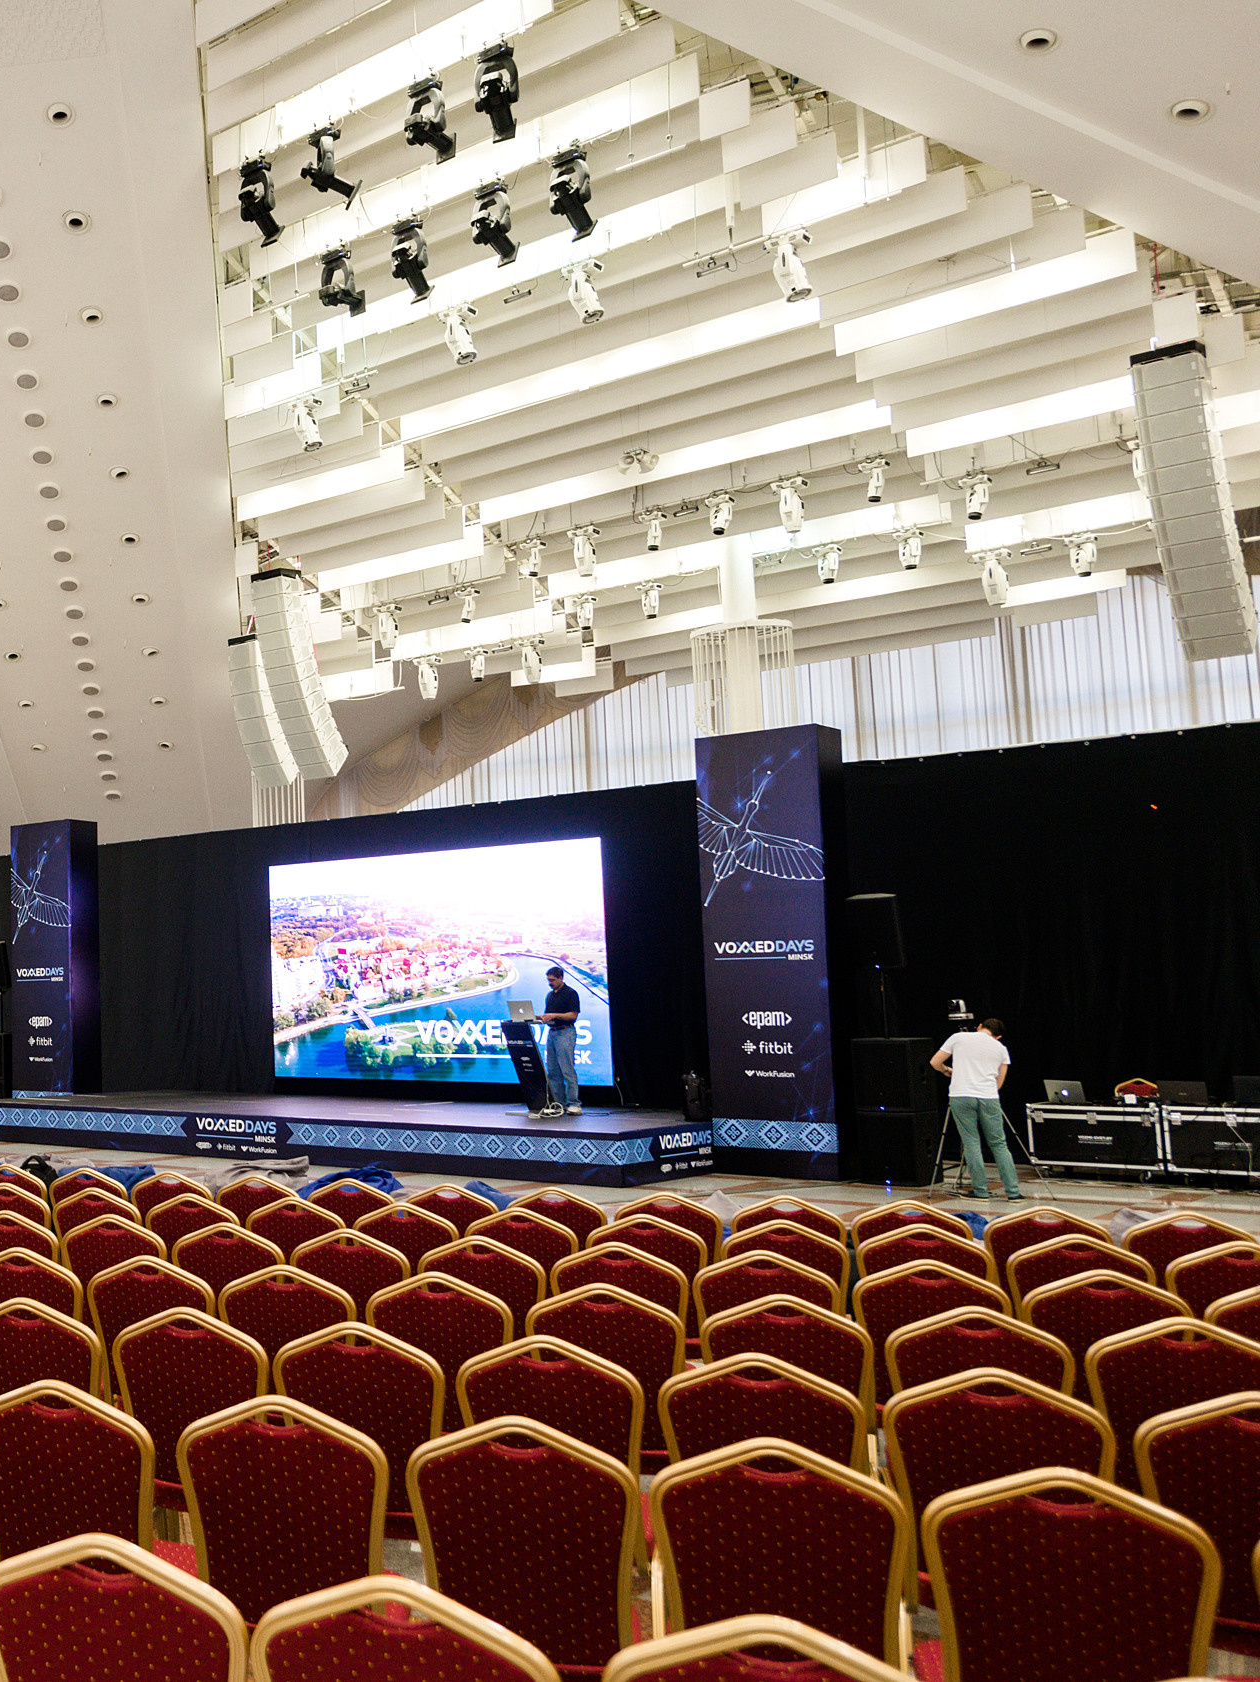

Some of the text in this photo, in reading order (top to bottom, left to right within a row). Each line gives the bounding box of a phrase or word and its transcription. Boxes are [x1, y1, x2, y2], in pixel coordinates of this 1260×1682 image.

[787, 953, 814, 961] MINSK
[36, 1036, 52, 1046] fitbit
[759, 1041, 793, 1054] fitbit
[755, 1070, 795, 1078] WorkFusion
[254, 1135, 276, 1143] MINSK
